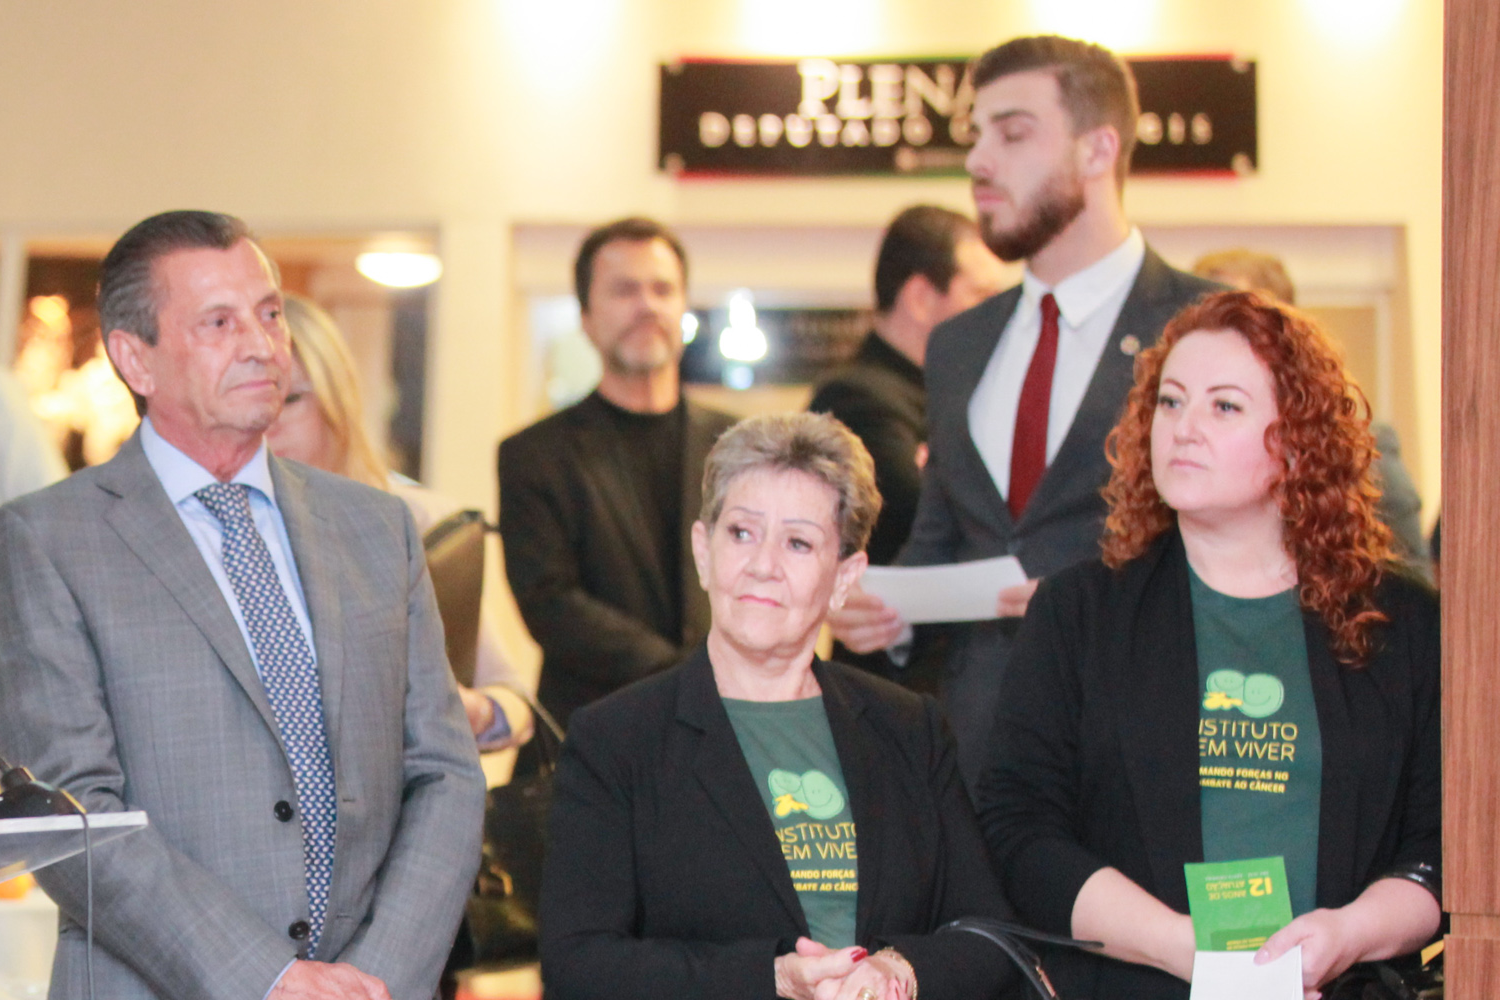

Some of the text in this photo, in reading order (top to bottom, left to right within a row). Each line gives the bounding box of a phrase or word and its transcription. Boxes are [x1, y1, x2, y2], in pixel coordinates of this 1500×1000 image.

[700, 111, 933, 148] DEPUTADO
[1199, 718, 1298, 741] STITUTO
[1199, 738, 1295, 762] EM VIVER
[1199, 766, 1289, 781] MANDO FORÇAS NO
[1234, 780, 1247, 790] AO
[1250, 780, 1286, 793] CÂNCER
[781, 842, 858, 860] EM VIVE
[822, 869, 856, 880] FORÇAS
[820, 882, 832, 891] AO
[1248, 877, 1273, 897] 12
